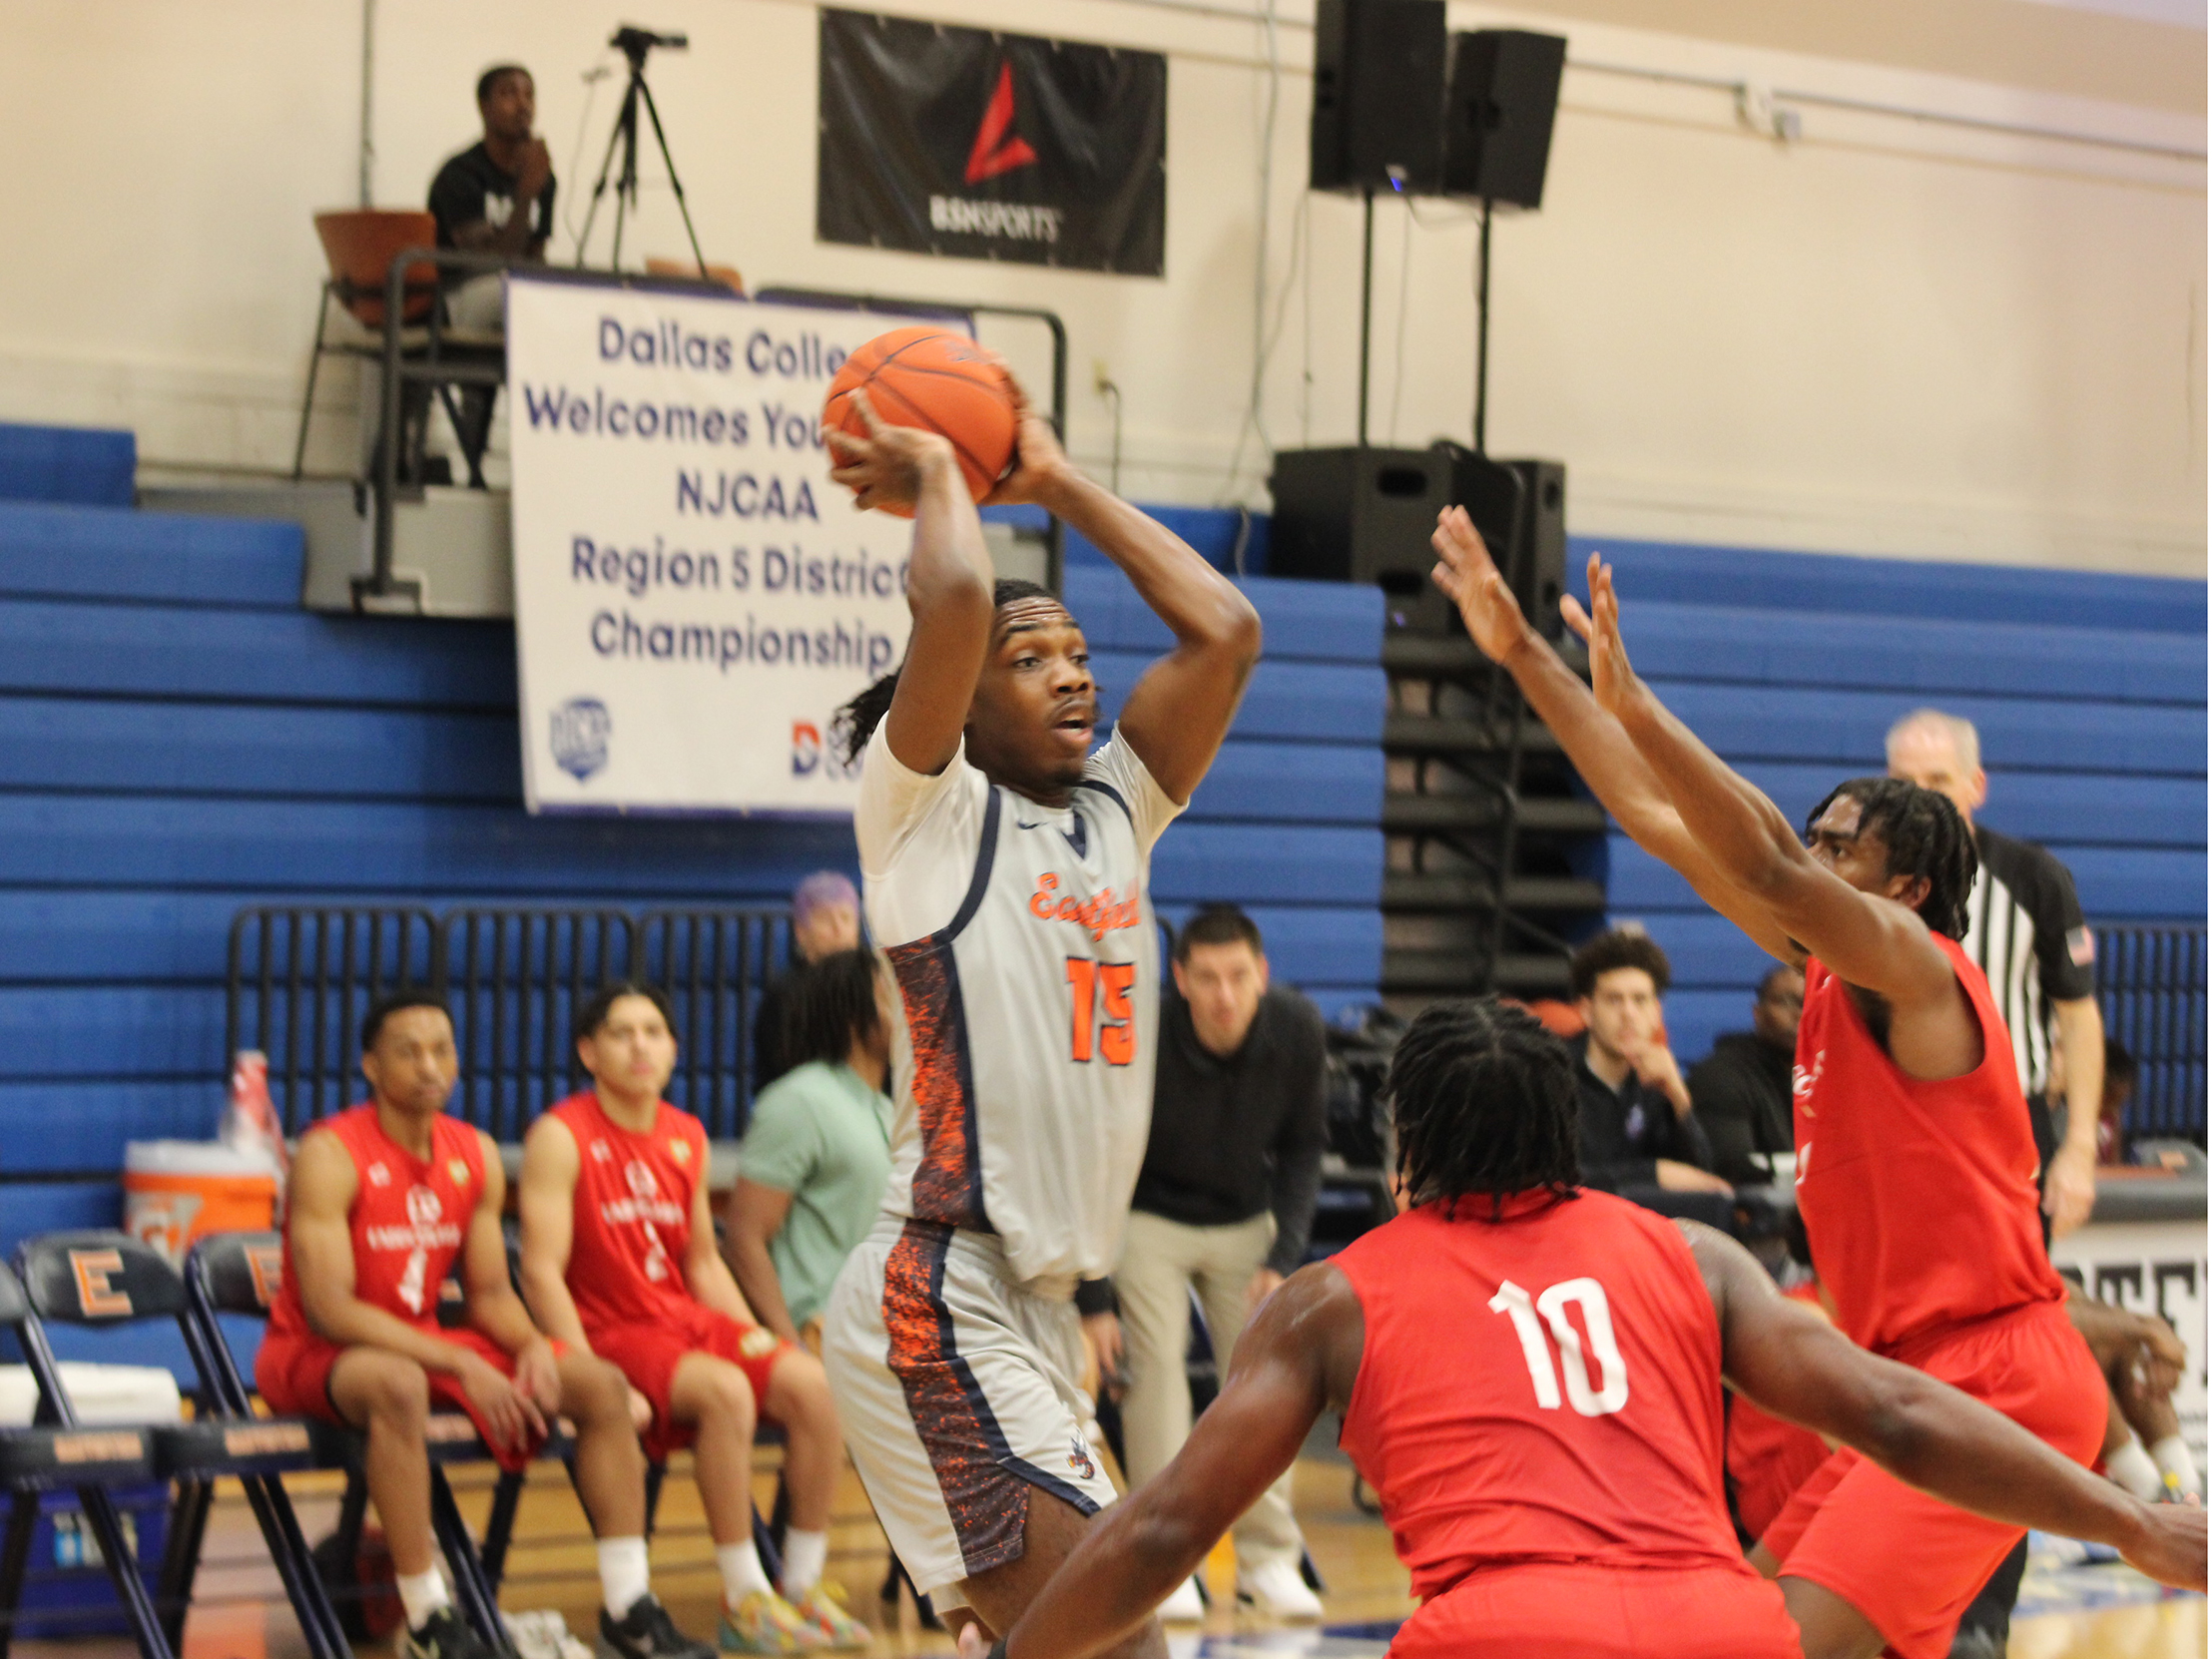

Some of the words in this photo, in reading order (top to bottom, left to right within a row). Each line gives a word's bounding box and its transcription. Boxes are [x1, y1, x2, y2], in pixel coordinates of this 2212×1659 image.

[599, 318, 733, 374] Dallas
[747, 330, 846, 381] Colle
[522, 381, 749, 445] Welcomes
[677, 470, 820, 521] NJCAA
[571, 537, 720, 596] Region
[732, 548, 750, 588] 5
[590, 609, 893, 678] Championship
[1065, 954, 1136, 1067] 15
[69, 1249, 133, 1318] E
[1486, 1277, 1629, 1417] 10
